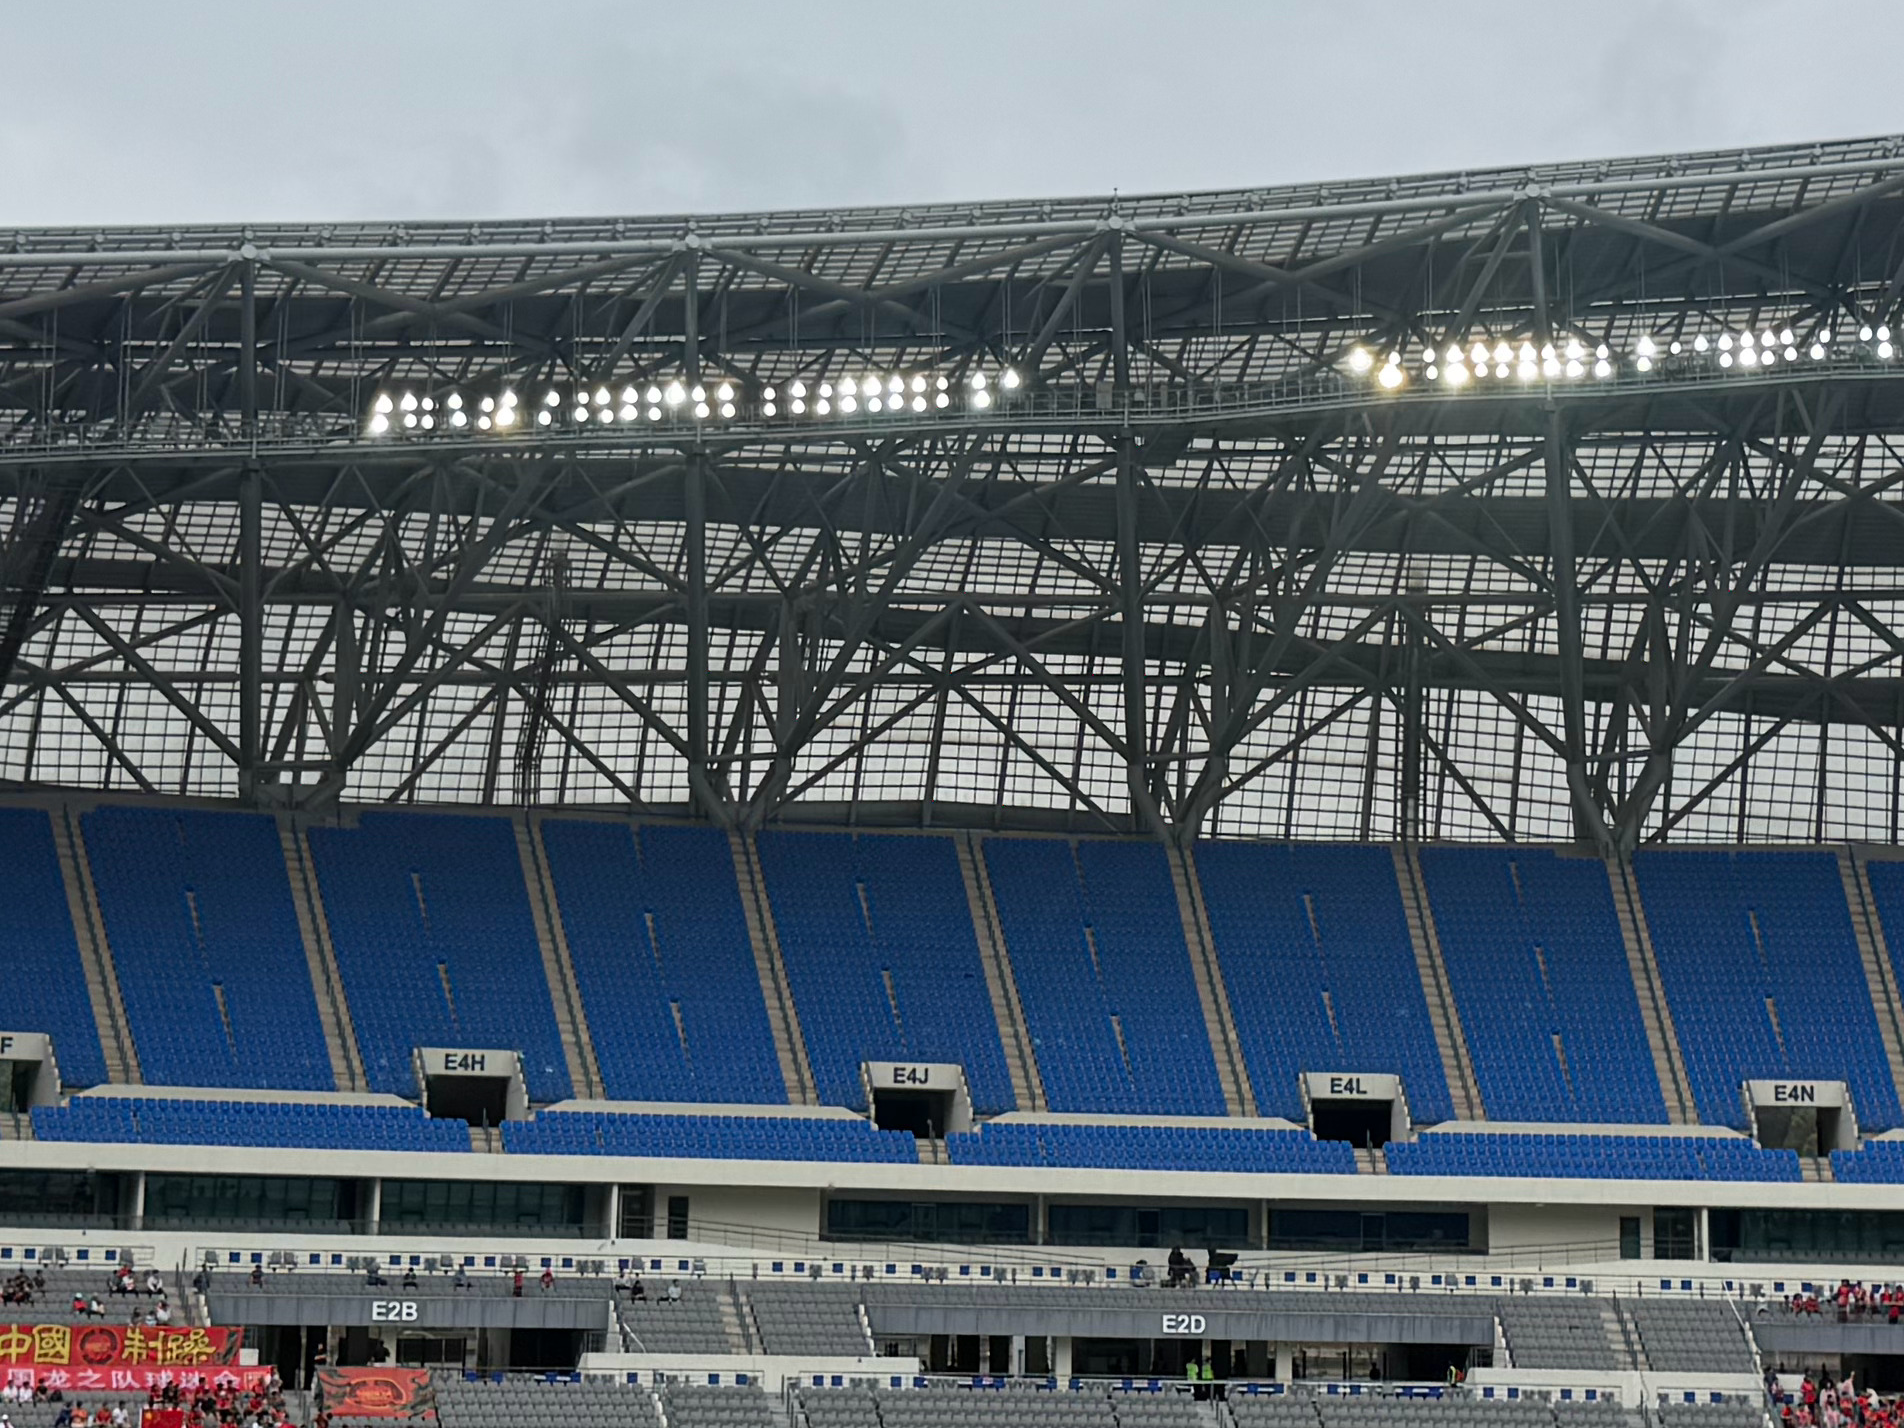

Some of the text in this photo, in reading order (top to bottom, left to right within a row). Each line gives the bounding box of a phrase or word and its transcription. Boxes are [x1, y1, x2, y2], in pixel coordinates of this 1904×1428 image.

[445, 1053, 485, 1072] E4H
[893, 1067, 929, 1085] E4J
[1330, 1077, 1367, 1095] E4L
[1774, 1084, 1815, 1103] E4N
[371, 1301, 419, 1322] E2B
[1162, 1315, 1206, 1333] E2D
